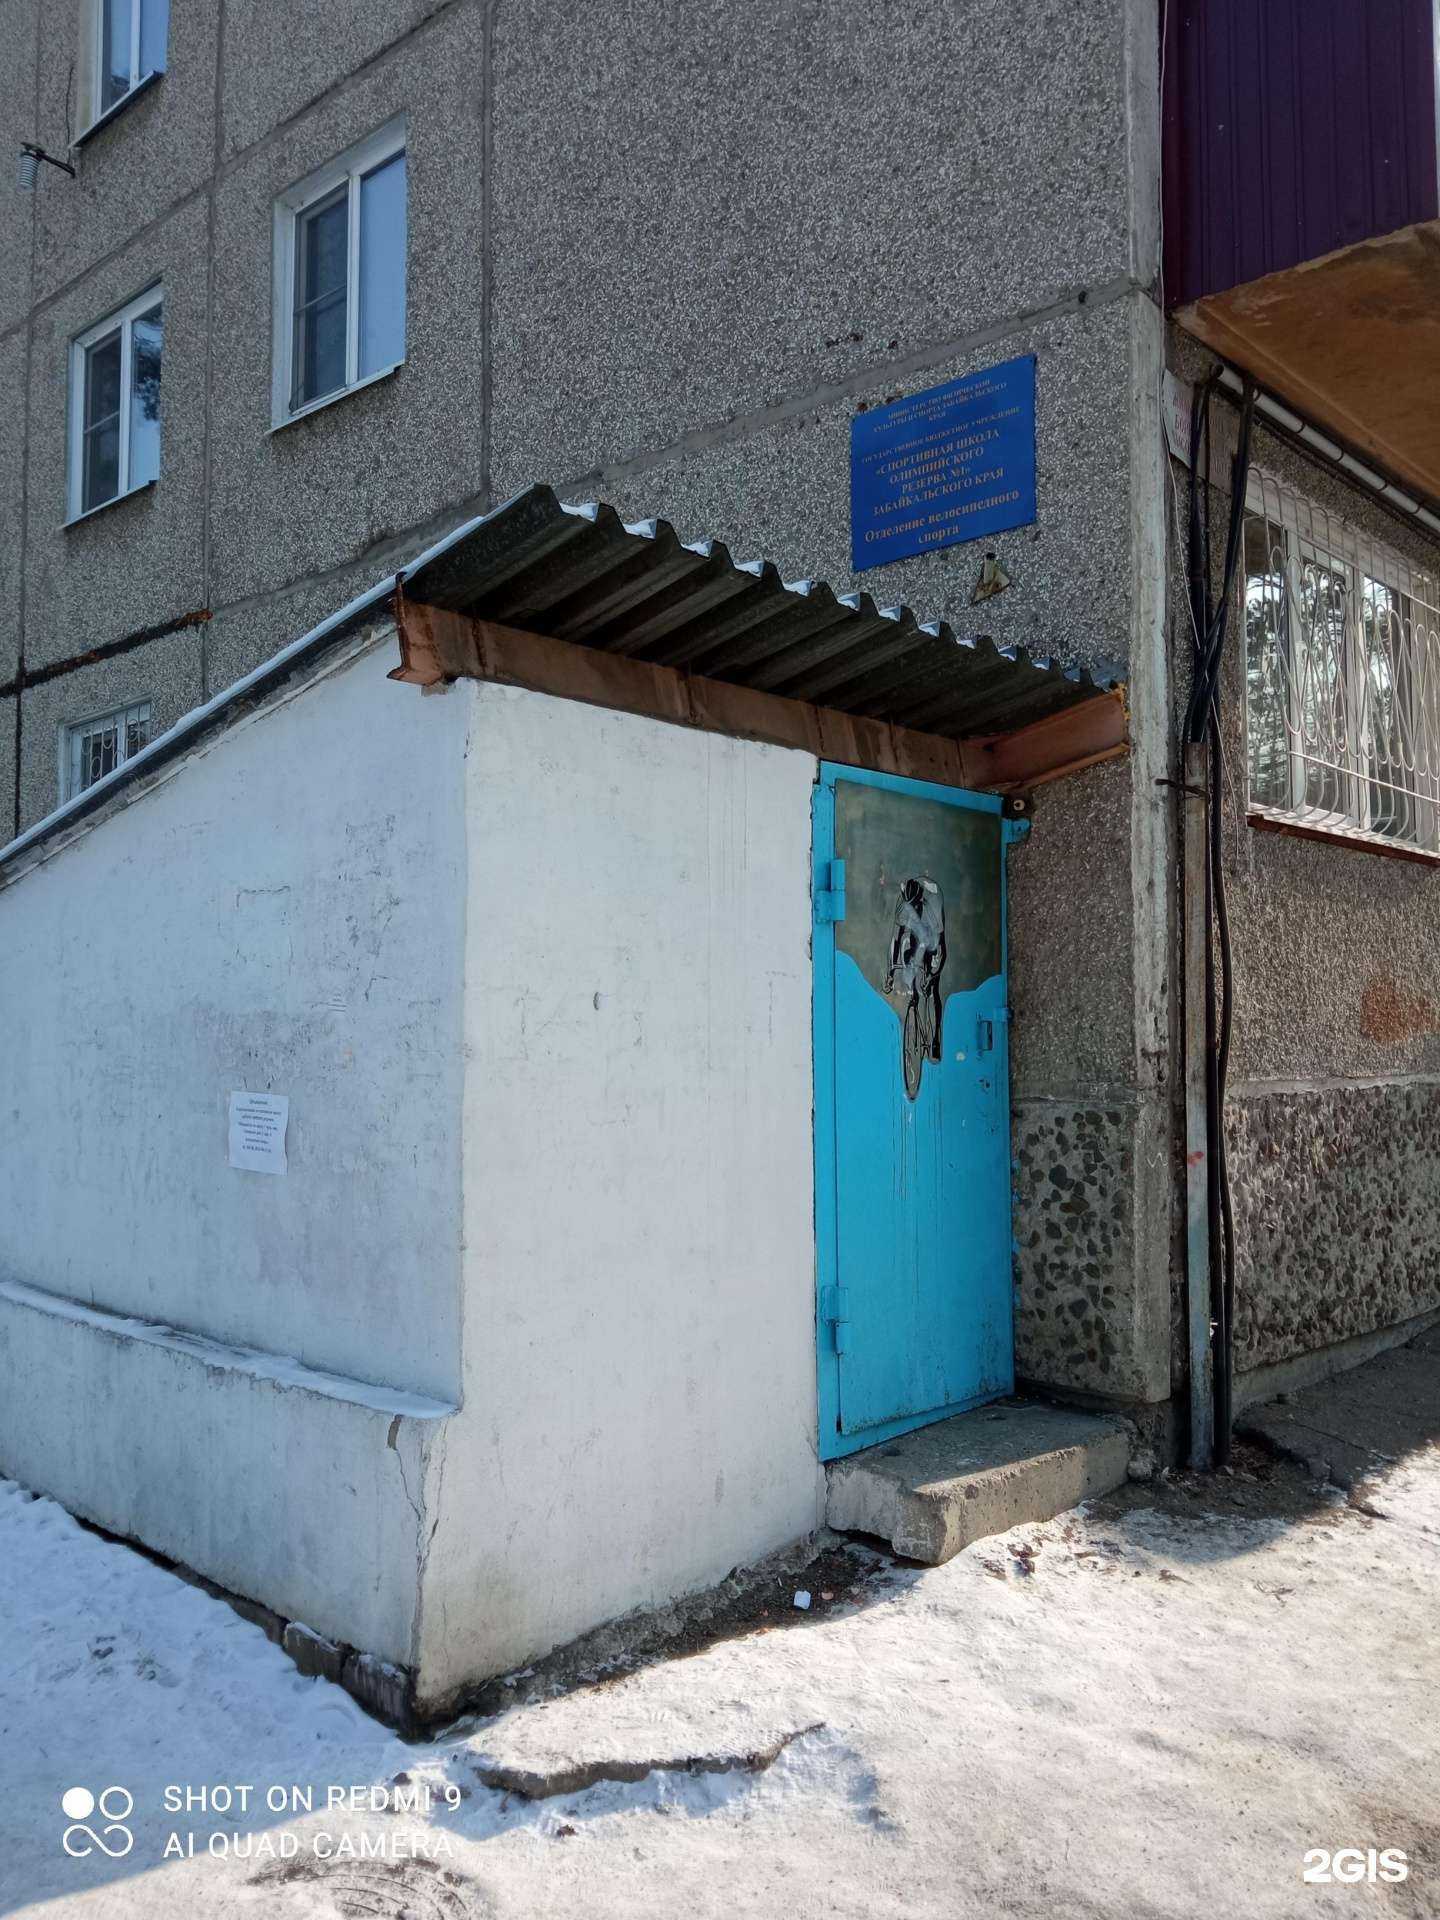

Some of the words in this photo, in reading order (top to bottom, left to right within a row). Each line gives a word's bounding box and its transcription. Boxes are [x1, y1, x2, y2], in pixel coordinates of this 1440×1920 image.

[956, 426, 999, 450] ШКОЛА
[873, 475, 972, 516] ЗАБАЙКАЛЬСКОГО
[975, 466, 1003, 485] КРАЯ
[902, 472, 946, 494] РЕЗЕРВА
[865, 514, 924, 544] Отделение
[928, 488, 1019, 524] велосипедного
[918, 524, 959, 546] спорта
